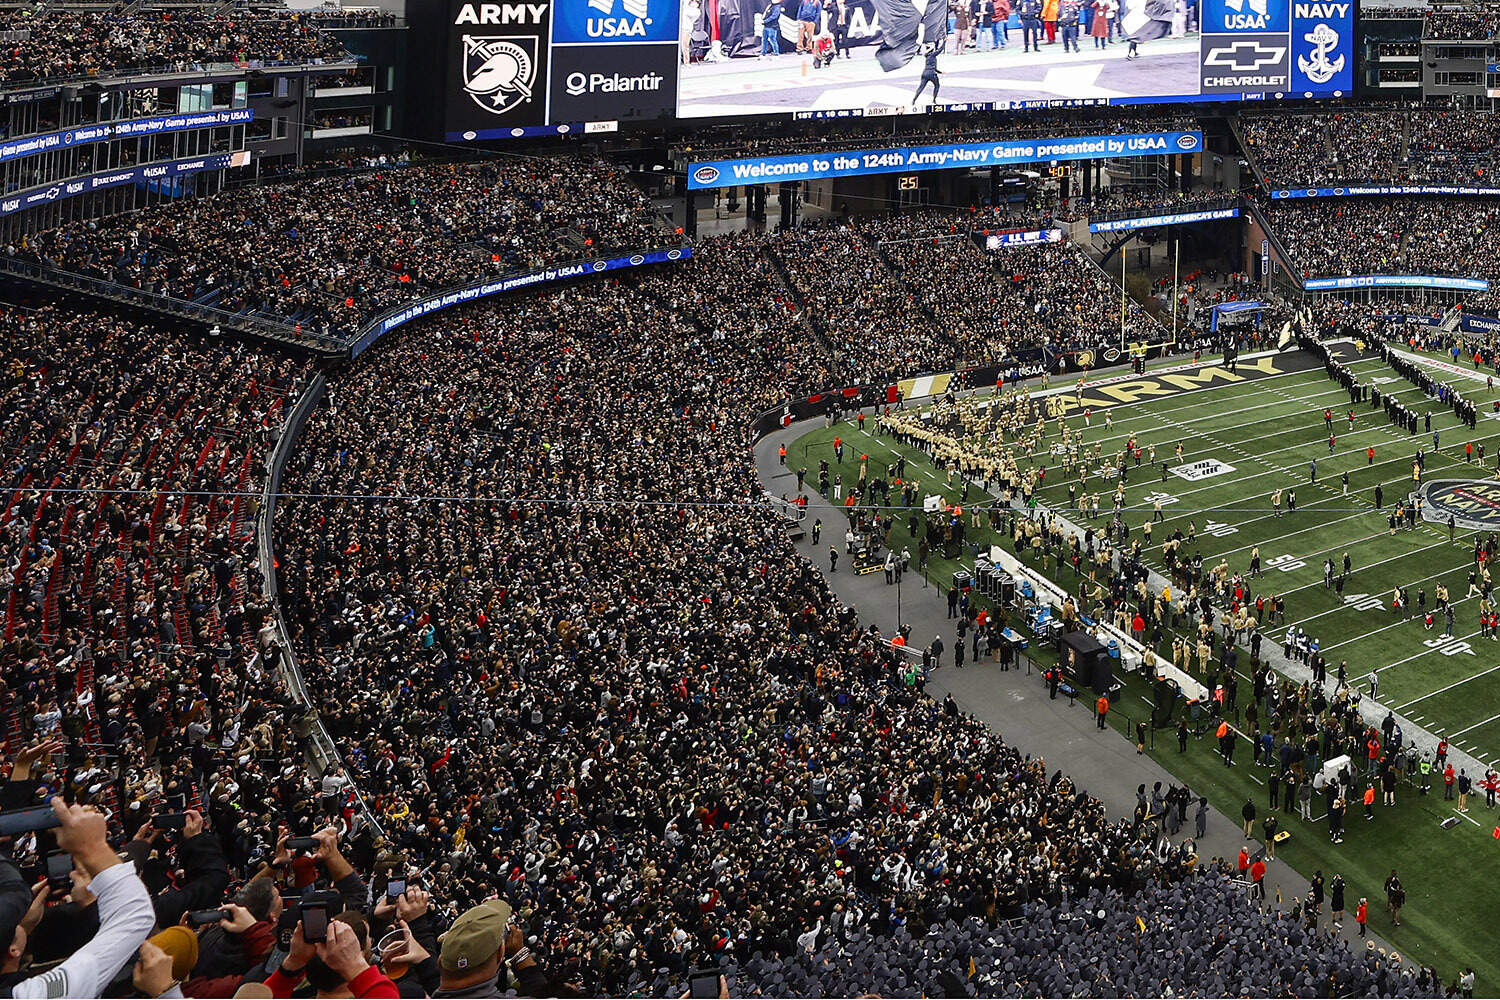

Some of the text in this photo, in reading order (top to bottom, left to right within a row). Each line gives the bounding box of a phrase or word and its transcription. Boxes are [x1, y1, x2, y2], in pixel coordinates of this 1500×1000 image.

[454, 3, 548, 25] ARMY
[1294, 3, 1350, 19] NAVY
[586, 17, 647, 37] USAA
[1224, 14, 1267, 30] USAA
[589, 72, 664, 93] Palantir
[1203, 75, 1287, 87] CHEVROLET
[221, 113, 229, 122] by
[230, 111, 249, 120] USAA
[733, 137, 1166, 178] Welcome to the 124th Army-Navy Game presented by USAA
[1049, 166, 1072, 176] 4:07
[901, 177, 917, 189] 25
[1097, 223, 1111, 231] THE
[1131, 217, 1163, 228] PLAYING
[1164, 215, 1174, 223] OF
[1174, 211, 1212, 222] AMERICA'S
[1213, 209, 1233, 218] GAME
[442, 265, 584, 305] Army-Navy Game presented by USAA
[1470, 319, 1500, 331] EXCHANGE
[1047, 356, 1285, 417] ARMY
[1265, 553, 1307, 572] 50
[1344, 593, 1384, 612] 40
[1423, 633, 1472, 656] 30
